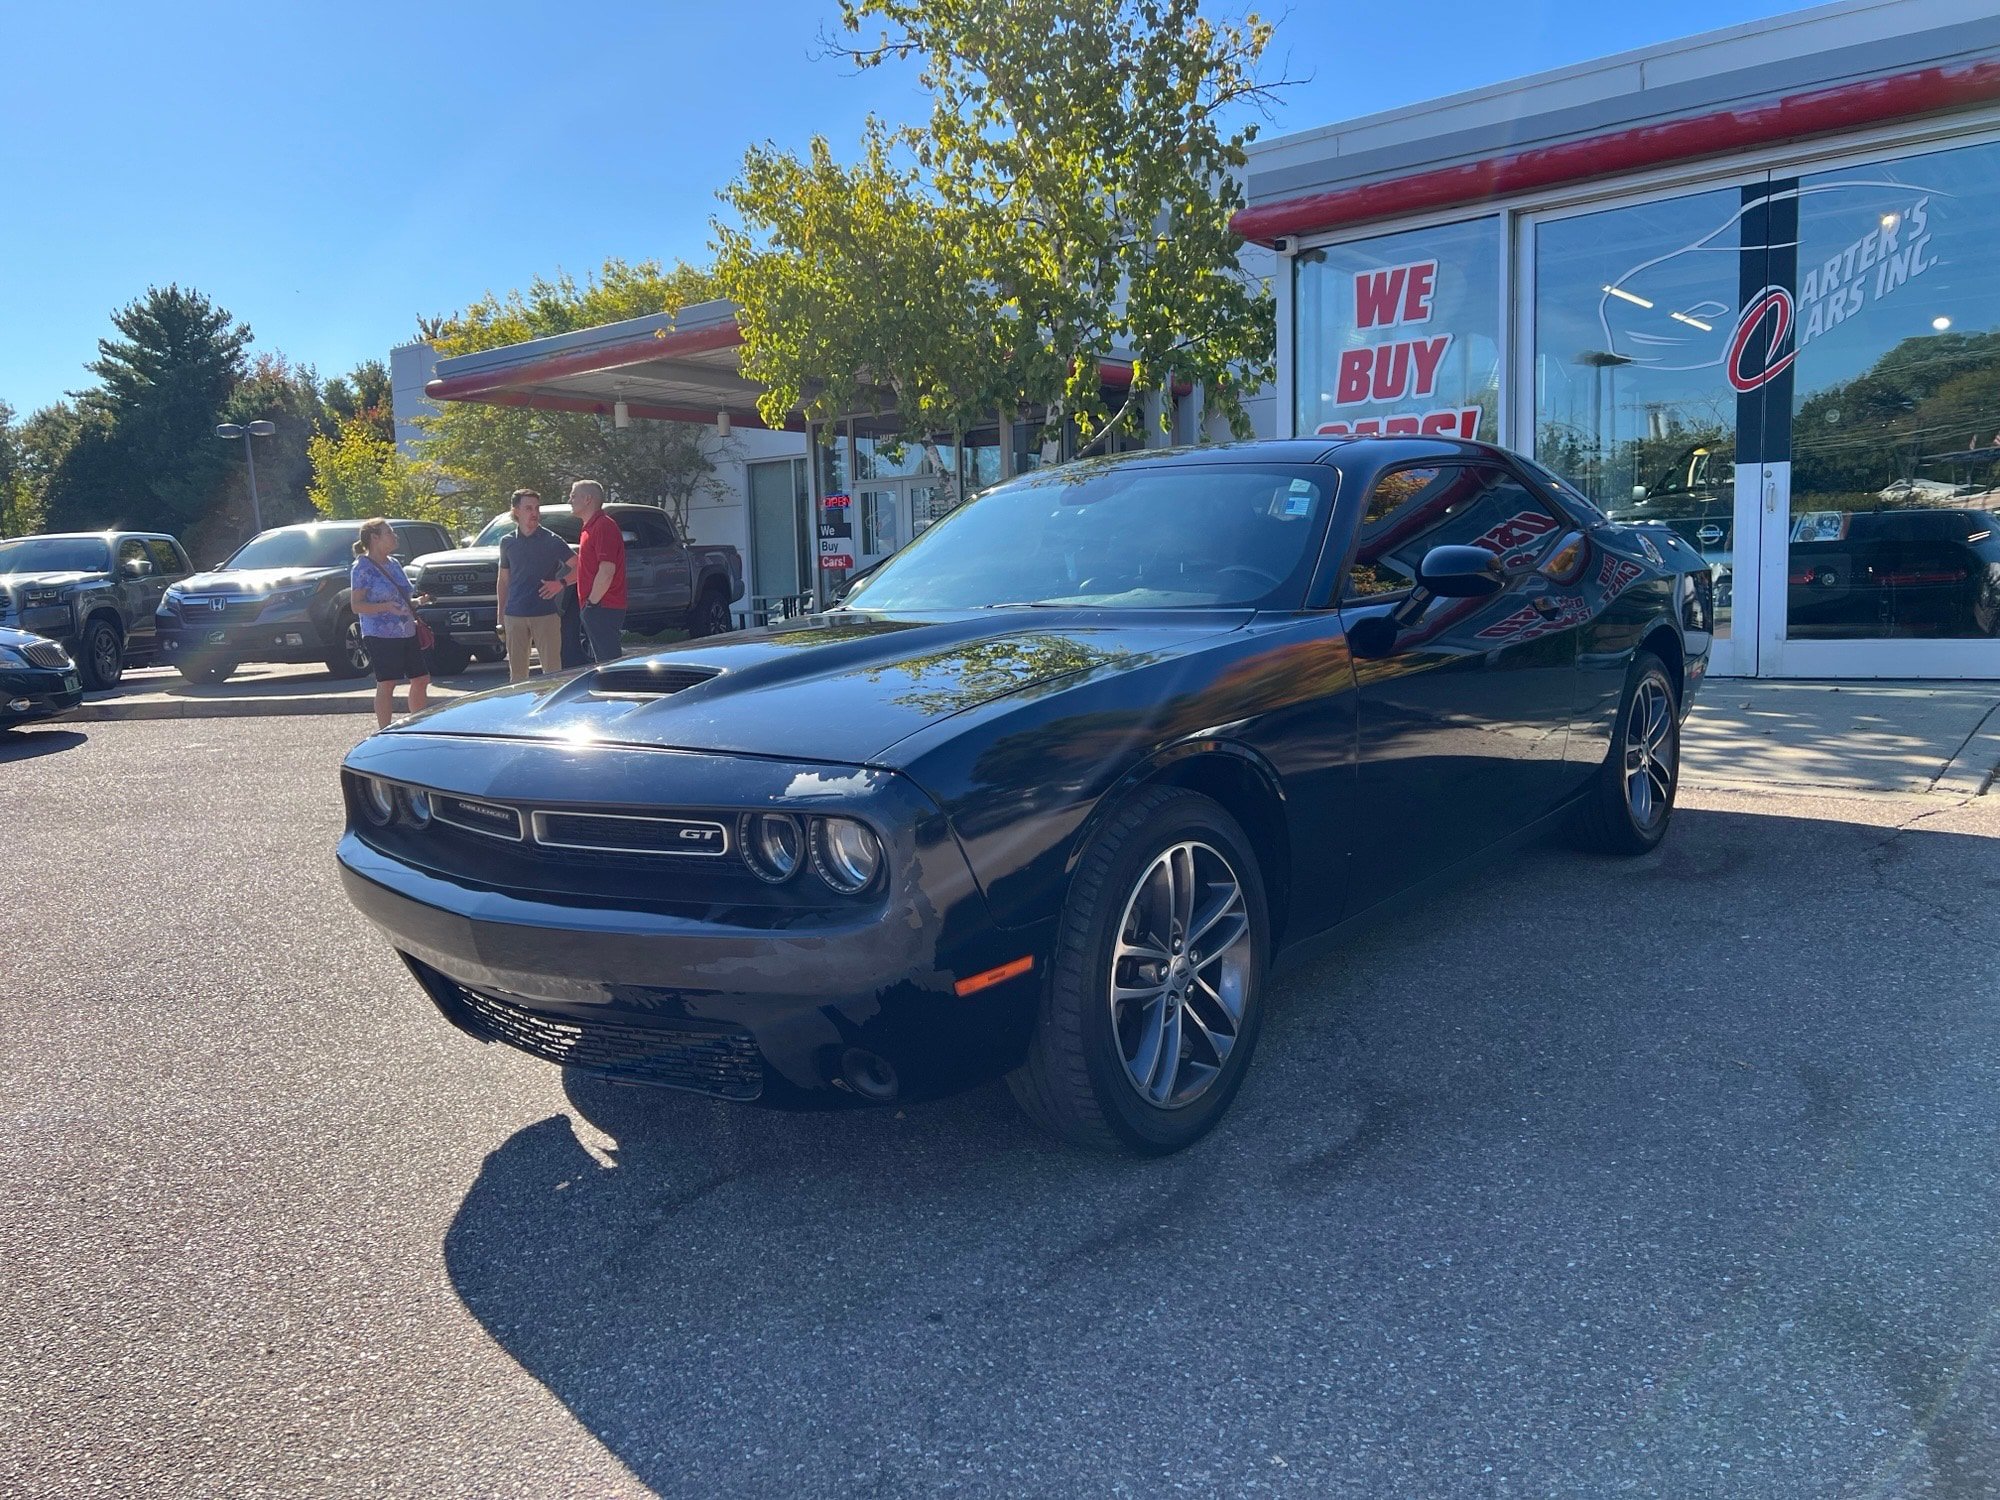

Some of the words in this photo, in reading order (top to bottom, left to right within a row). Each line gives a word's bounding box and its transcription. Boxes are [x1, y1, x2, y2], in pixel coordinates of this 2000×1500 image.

[1875, 233, 1938, 301] INC.
[1354, 260, 1437, 329] WE
[1334, 334, 1452, 406] BUY
[820, 525, 835, 536] We
[821, 541, 838, 553] Buy
[822, 556, 846, 568] Cars!
[441, 573, 476, 582] TOYOTA
[680, 829, 720, 839] GT
